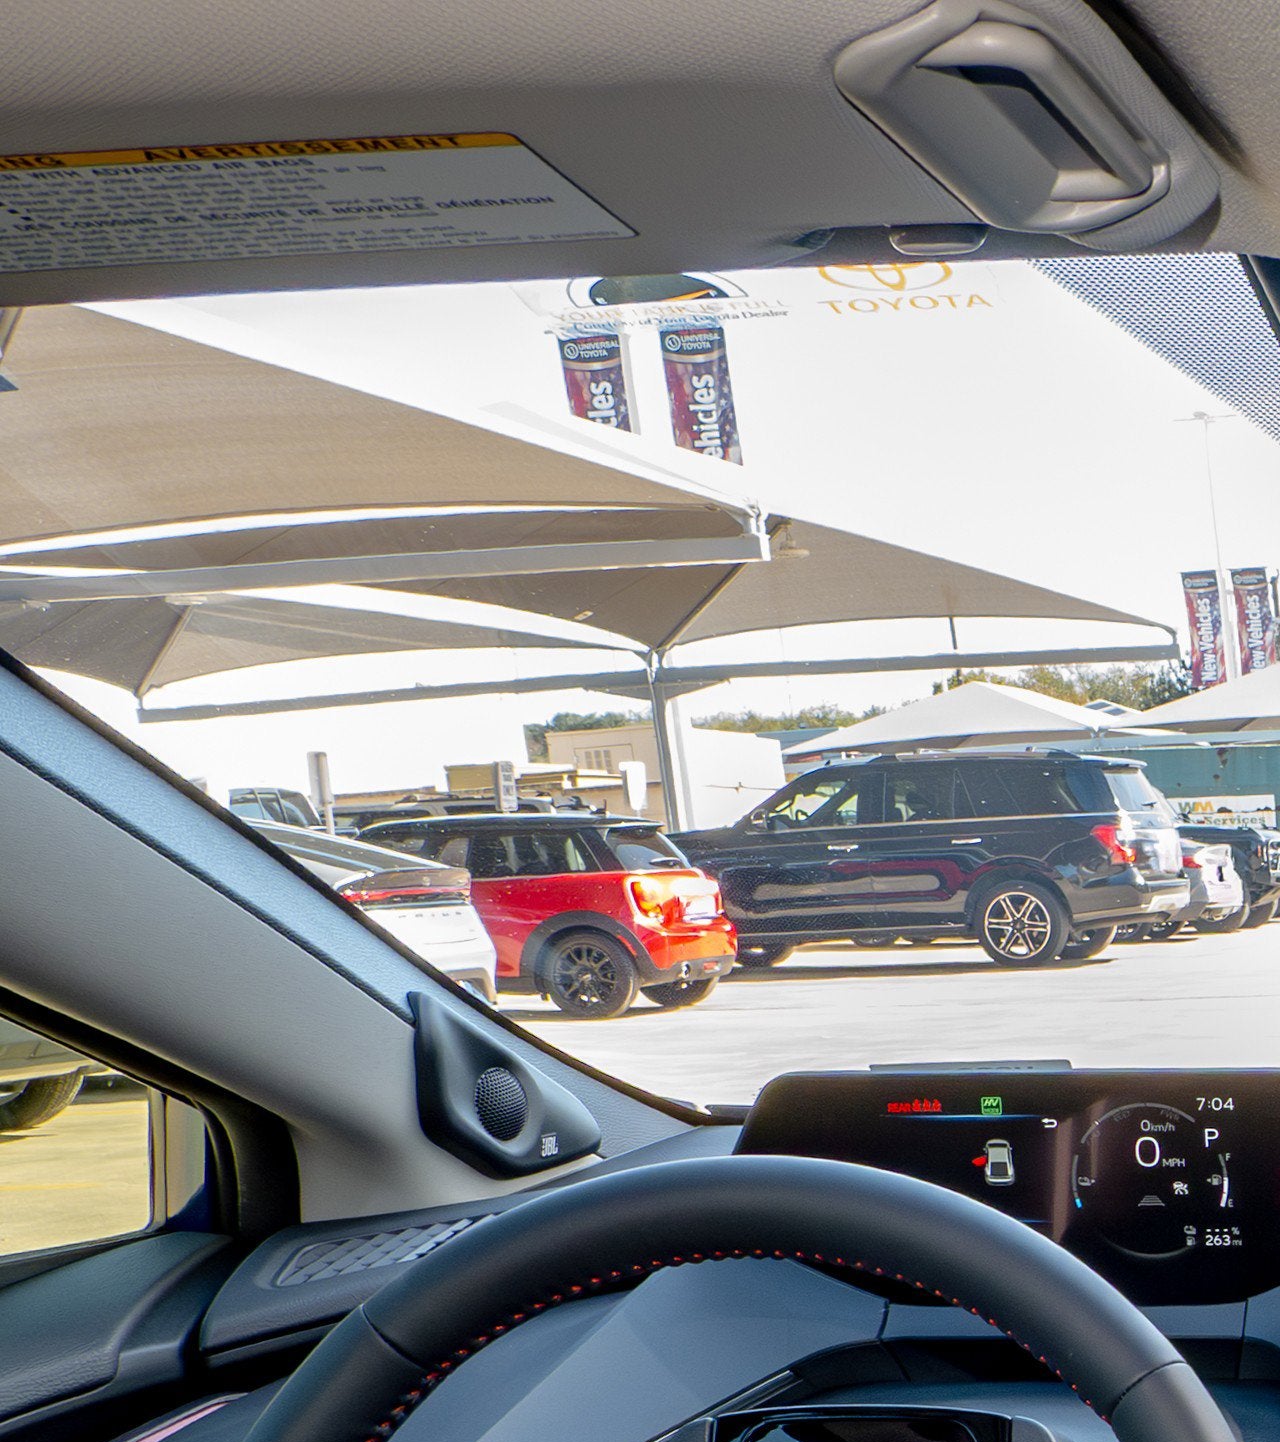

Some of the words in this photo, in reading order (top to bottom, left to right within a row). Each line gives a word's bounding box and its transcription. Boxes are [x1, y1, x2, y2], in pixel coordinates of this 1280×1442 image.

[143, 134, 461, 164] AVERTISSEMENT
[817, 294, 994, 315] TOYOTA
[578, 339, 619, 351] UNIVERSAL
[681, 341, 712, 352] TOYOTA
[579, 349, 609, 360] TOYOTA
[1195, 598, 1216, 653] Vehicles
[1245, 594, 1264, 649] Vehicles
[1201, 653, 1219, 682] New
[887, 1102, 912, 1113] REAR
[983, 1099, 999, 1107] HV
[1196, 1097, 1235, 1112] 7:04
[1204, 1128, 1219, 1148] P
[1134, 1136, 1160, 1168] 0
[1162, 1158, 1186, 1168] MPH
[1225, 1153, 1231, 1162] F
[1228, 1199, 1234, 1208] E
[1205, 1235, 1231, 1247] 263
